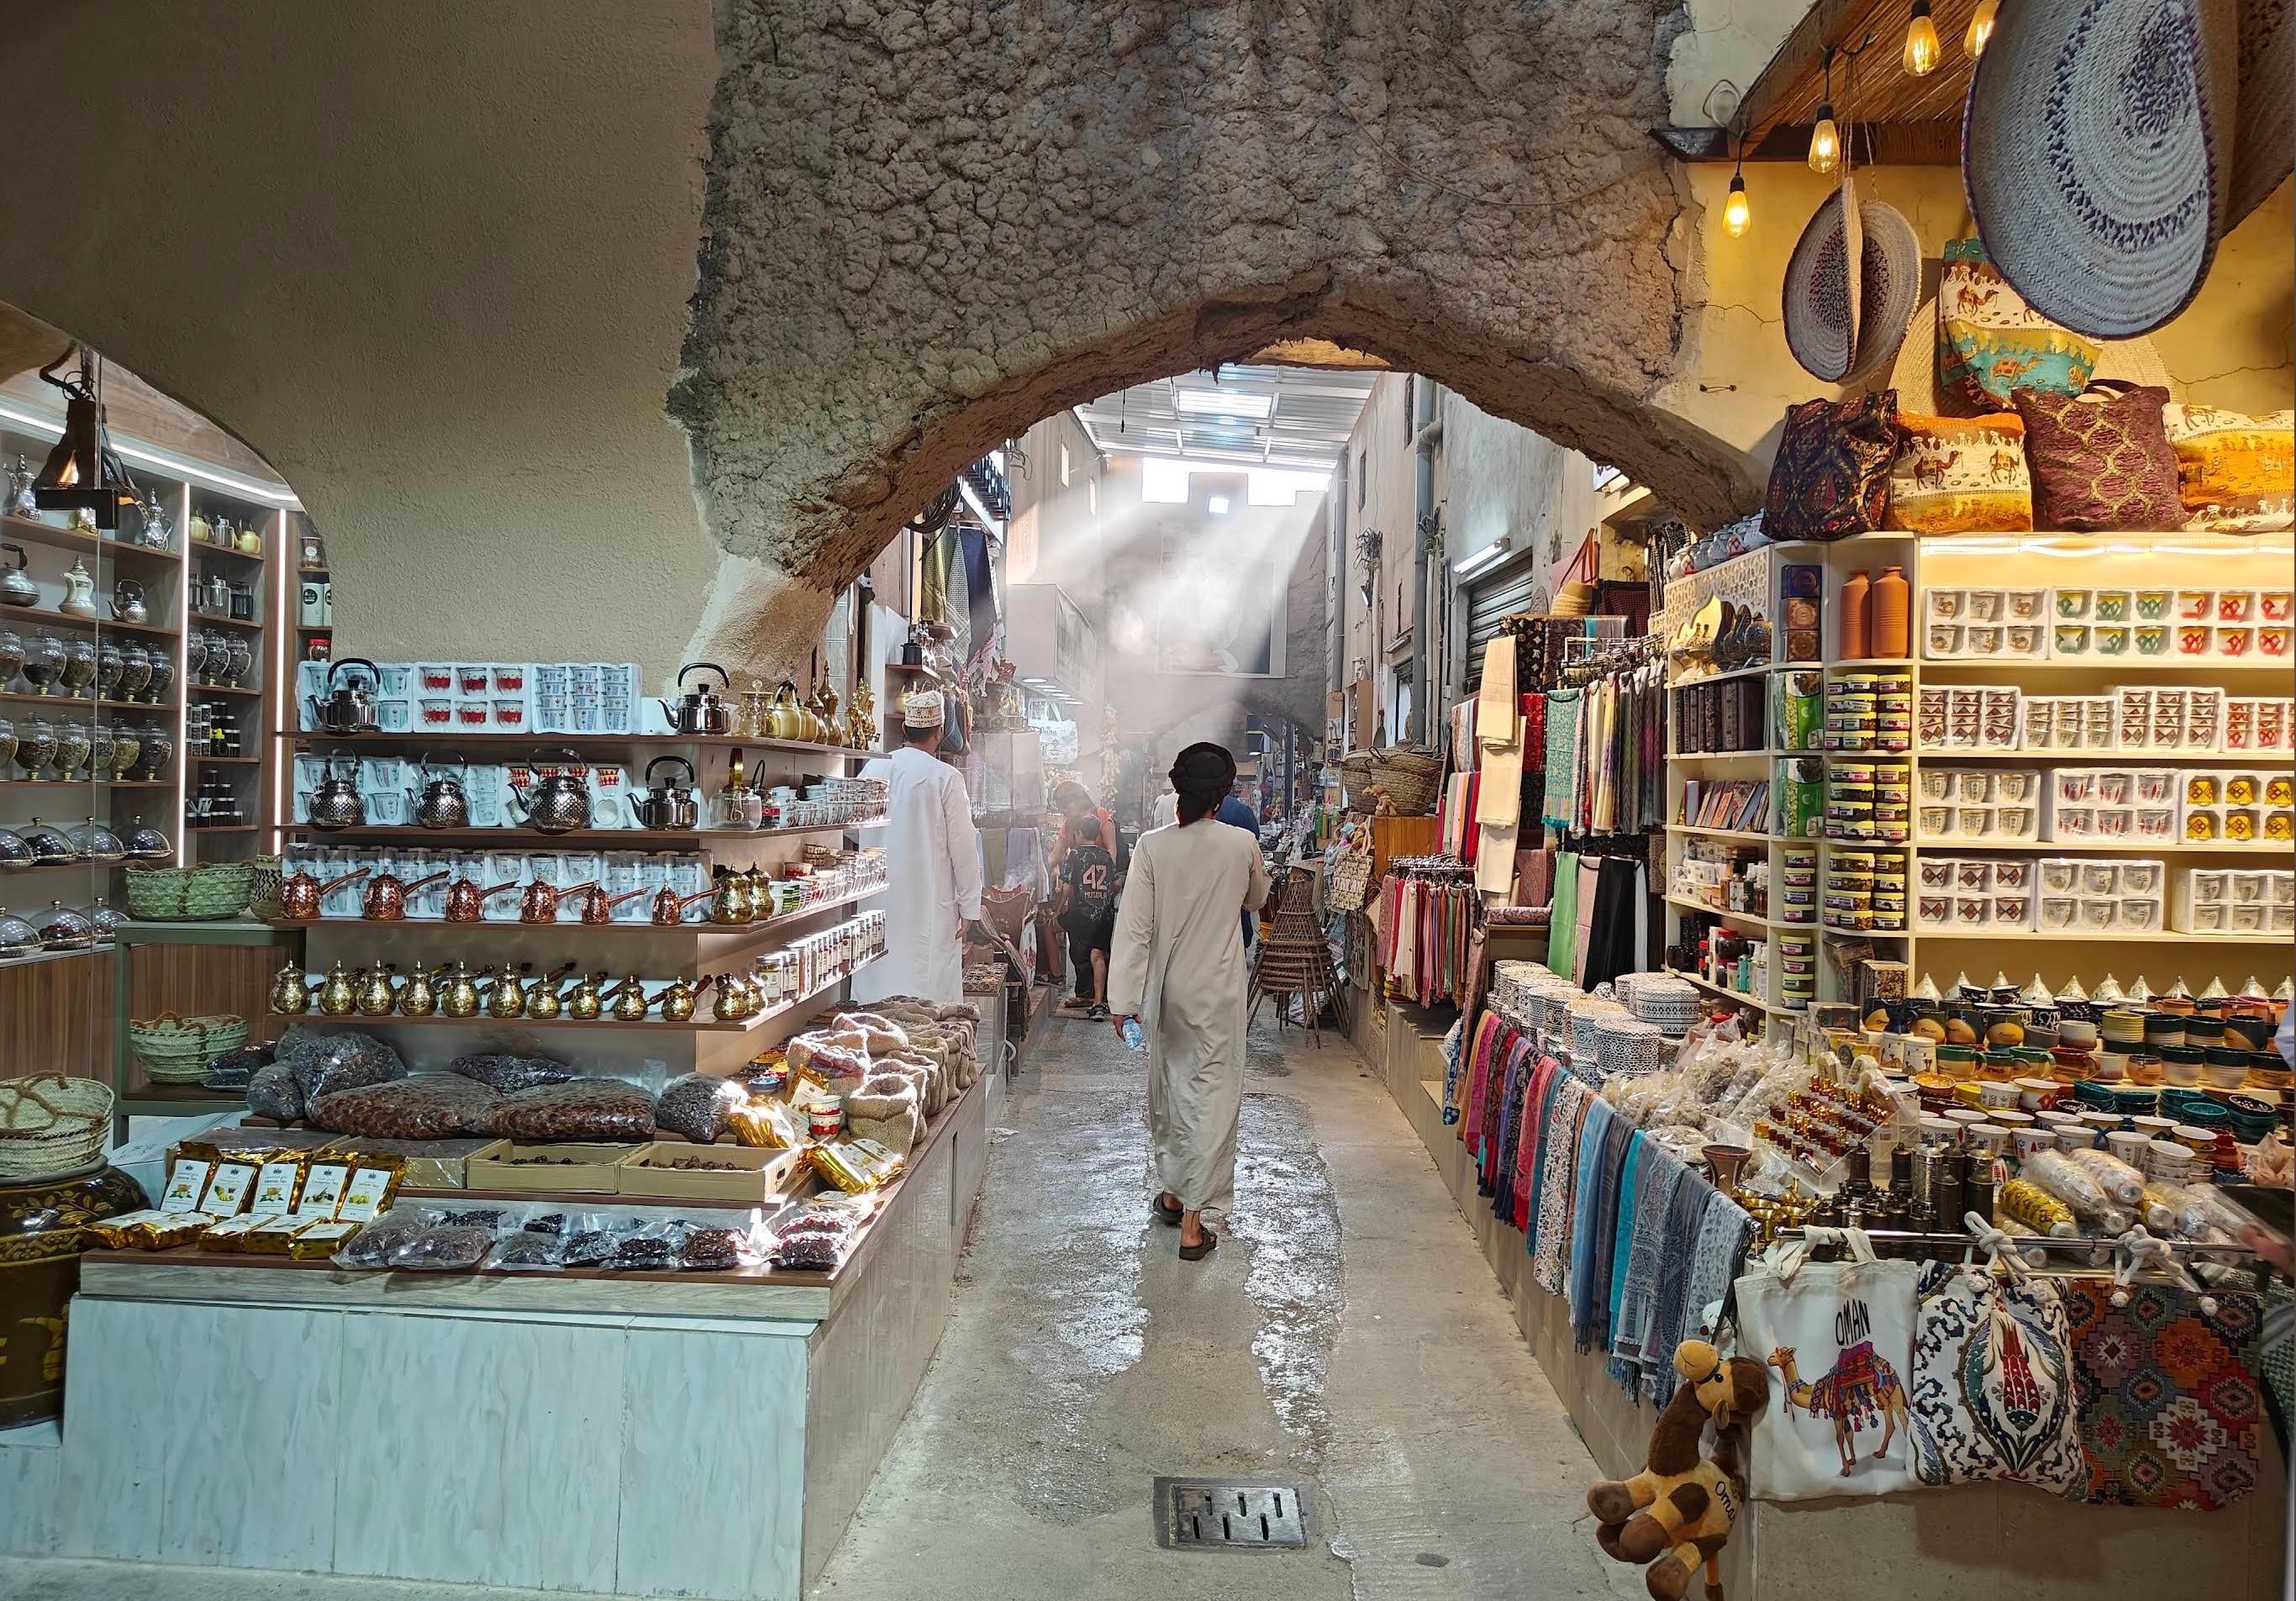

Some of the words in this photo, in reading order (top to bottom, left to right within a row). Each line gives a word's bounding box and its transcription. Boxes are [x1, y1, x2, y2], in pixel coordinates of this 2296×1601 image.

[1083, 865, 1108, 890] 42
[1835, 1298, 1871, 1346] OMAN
[1715, 1481, 1736, 1525] Oma
